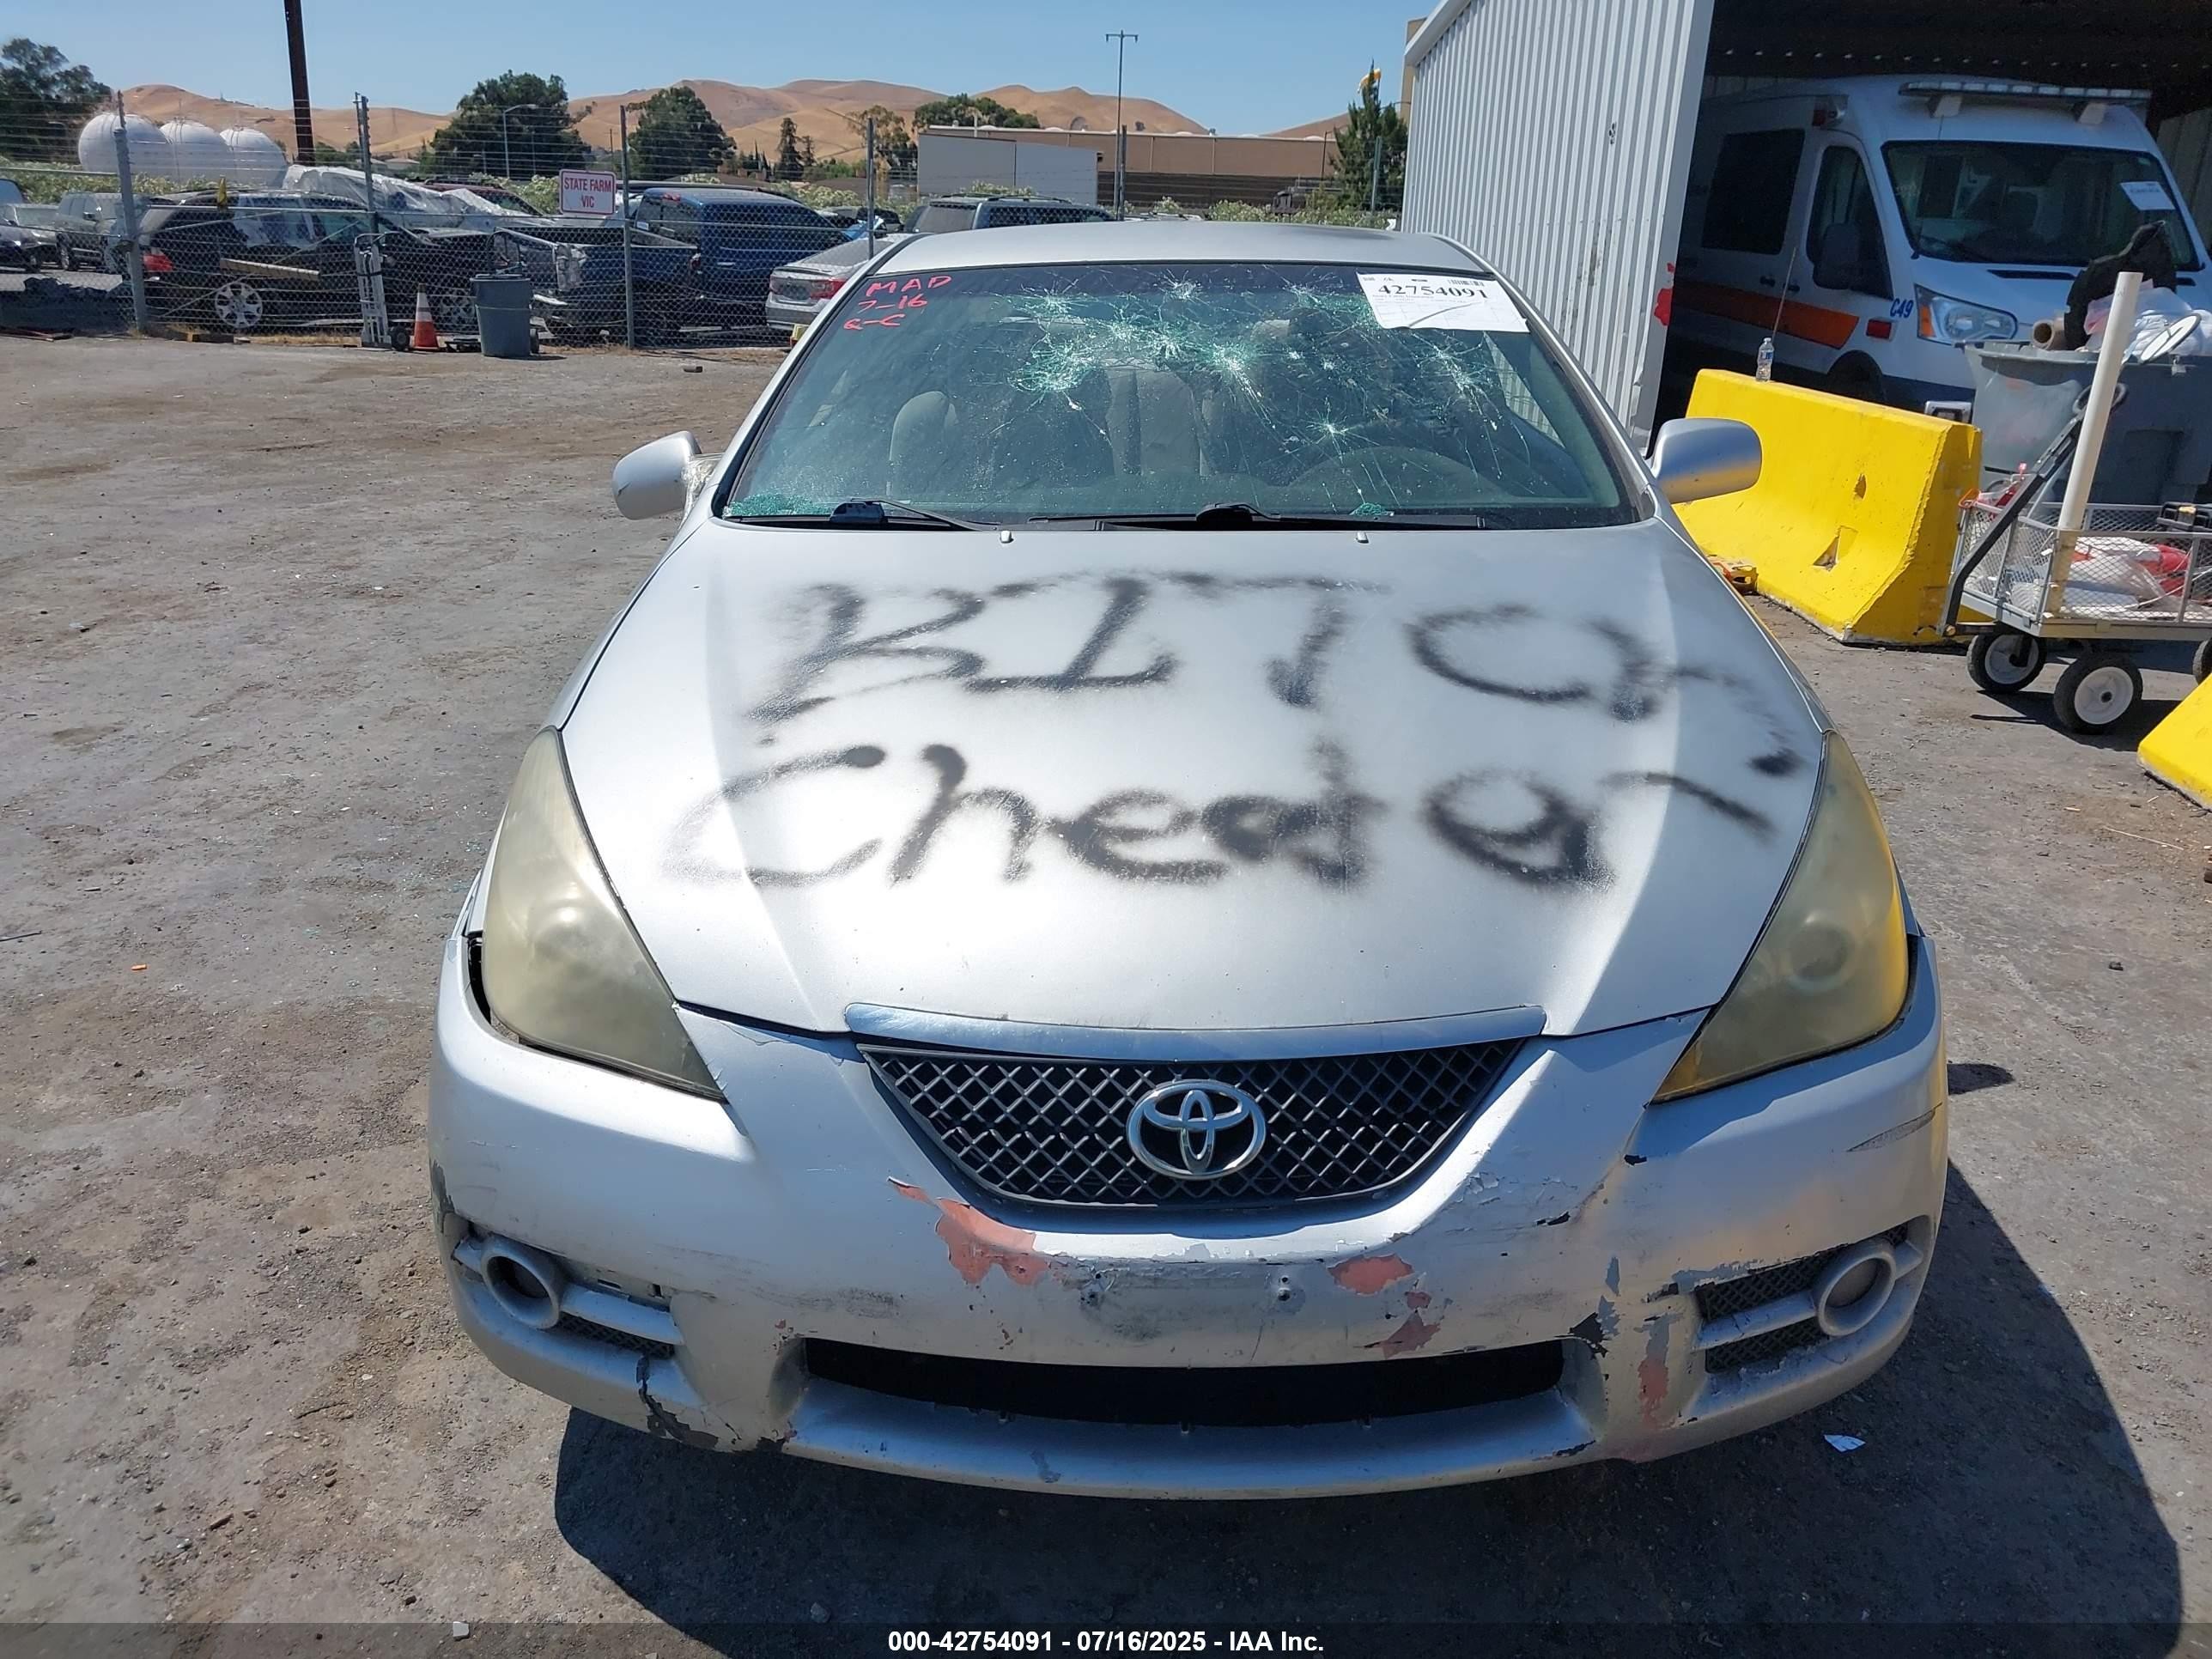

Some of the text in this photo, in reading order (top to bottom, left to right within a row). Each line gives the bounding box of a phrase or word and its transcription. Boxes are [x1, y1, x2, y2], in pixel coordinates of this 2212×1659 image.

[564, 178, 611, 192] STATE FARM
[581, 196, 594, 208] VIC
[1378, 284, 1488, 299] 42754091
[1890, 298, 1914, 318] C49
